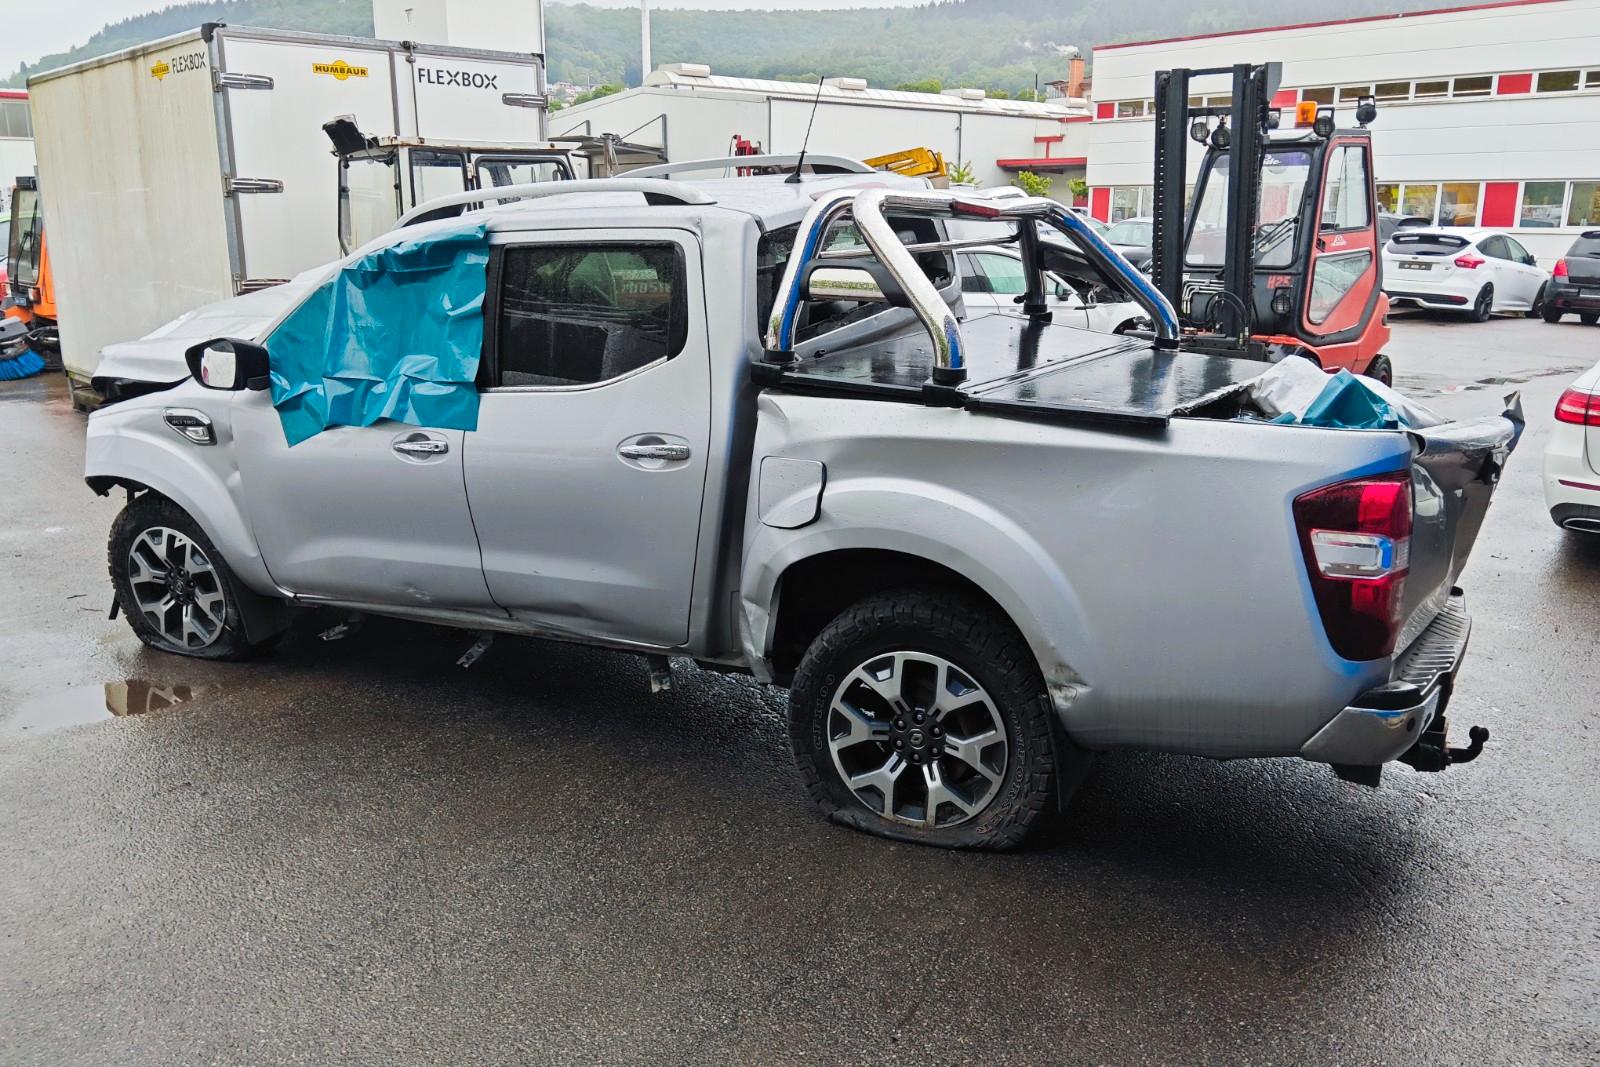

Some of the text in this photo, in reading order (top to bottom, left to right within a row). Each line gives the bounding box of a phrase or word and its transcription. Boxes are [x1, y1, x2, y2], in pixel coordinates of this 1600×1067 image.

[171, 52, 207, 74] FLEXBOX
[314, 64, 367, 76] HUMBAUR
[417, 67, 498, 90] FLEXBOX
